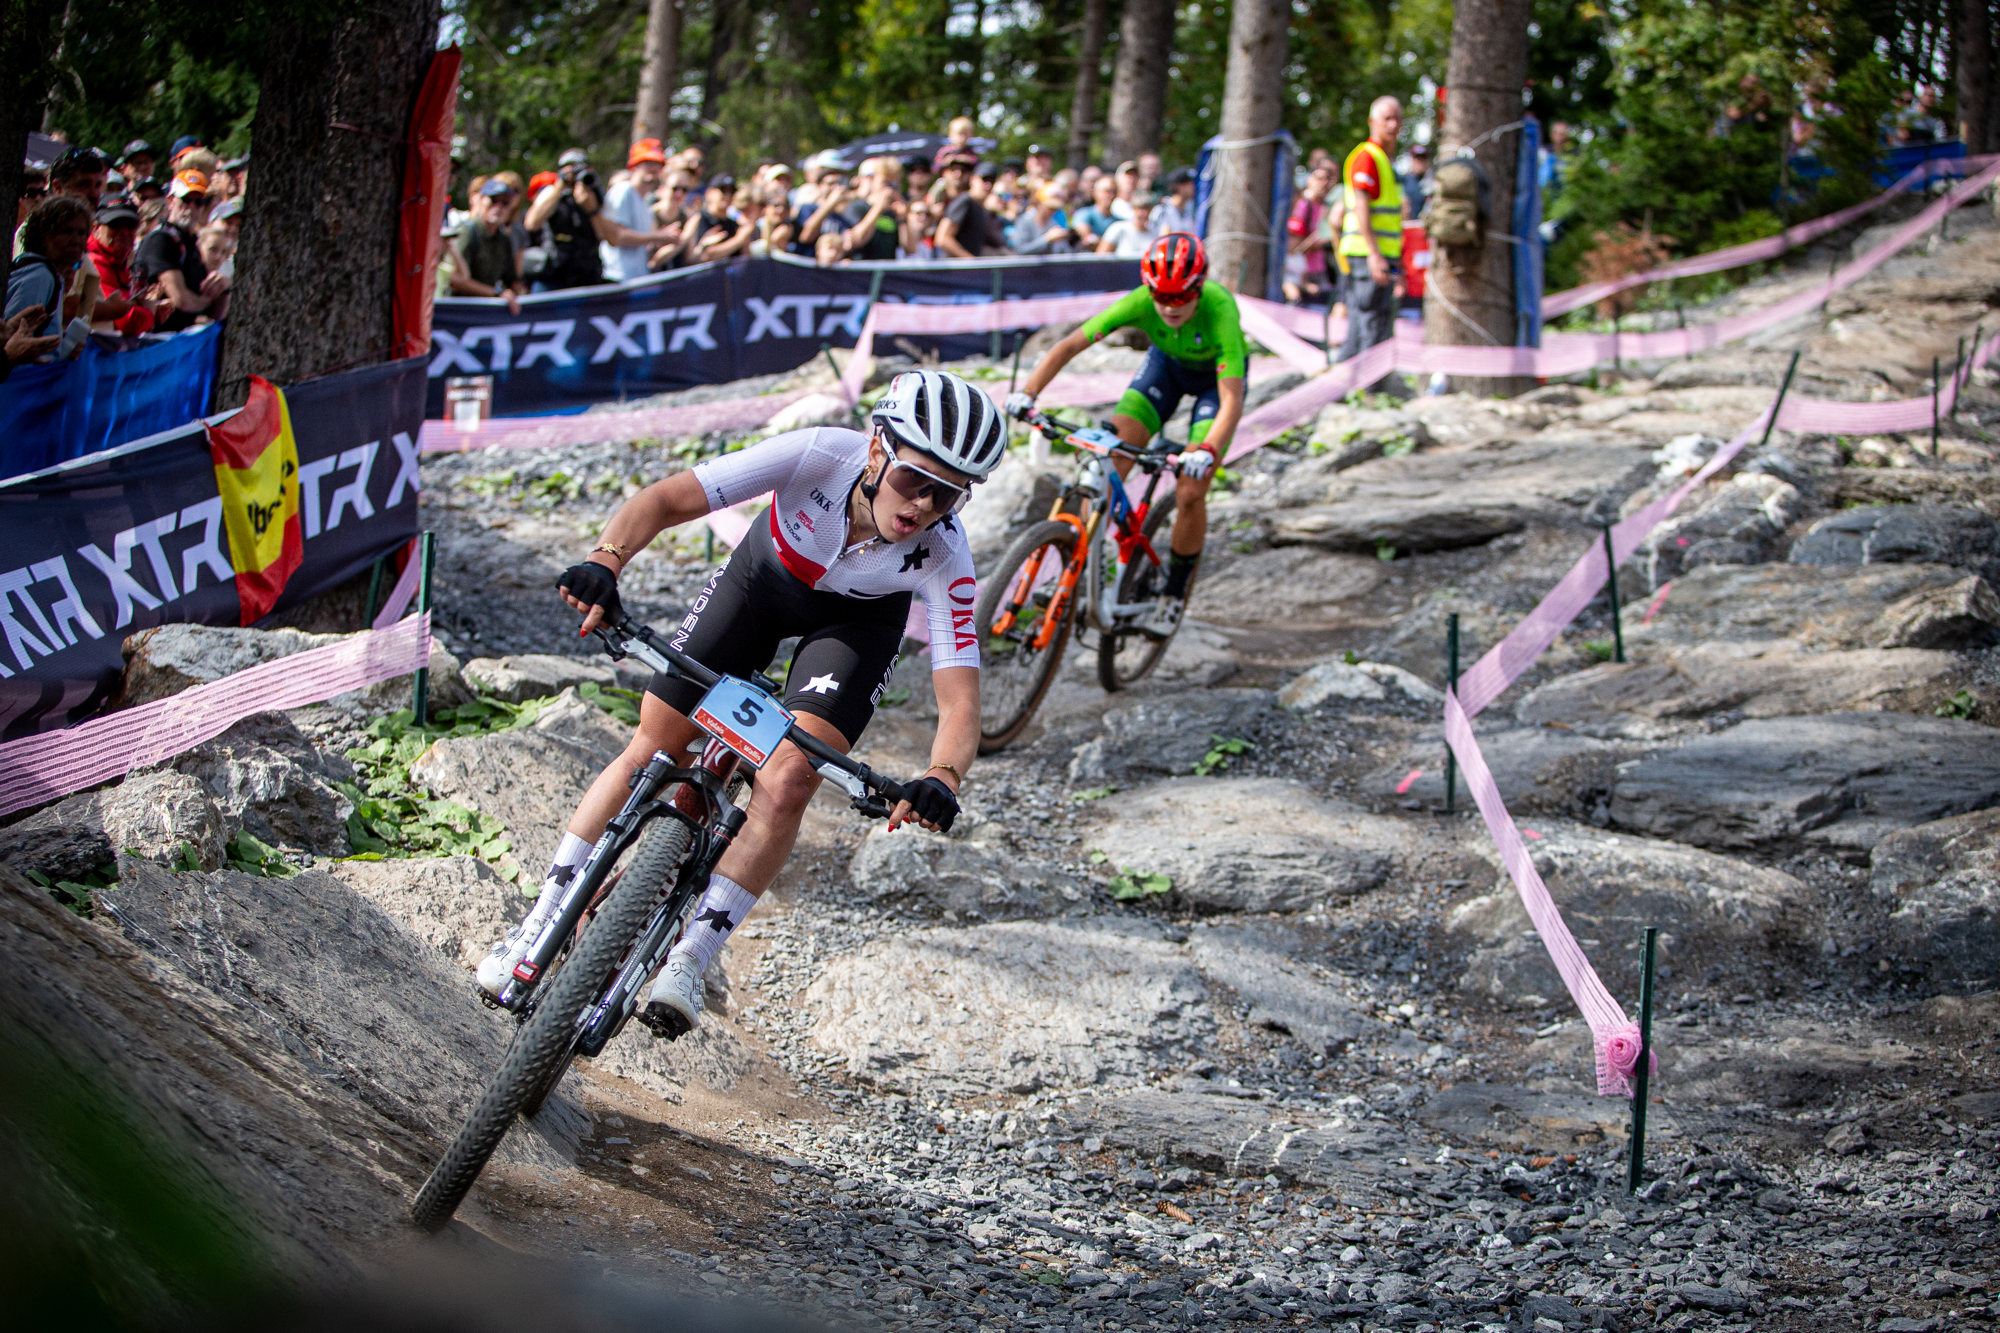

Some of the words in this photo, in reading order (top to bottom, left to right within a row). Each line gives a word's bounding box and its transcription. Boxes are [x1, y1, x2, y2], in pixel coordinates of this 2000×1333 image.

[428, 319, 577, 378] XTR
[589, 303, 718, 364] XTR
[744, 294, 872, 343] XTR
[77, 495, 236, 631] XTR
[298, 440, 381, 540] TR
[706, 717, 725, 735] Valais
[743, 744, 762, 761] Wallis
[731, 697, 764, 727] 5
